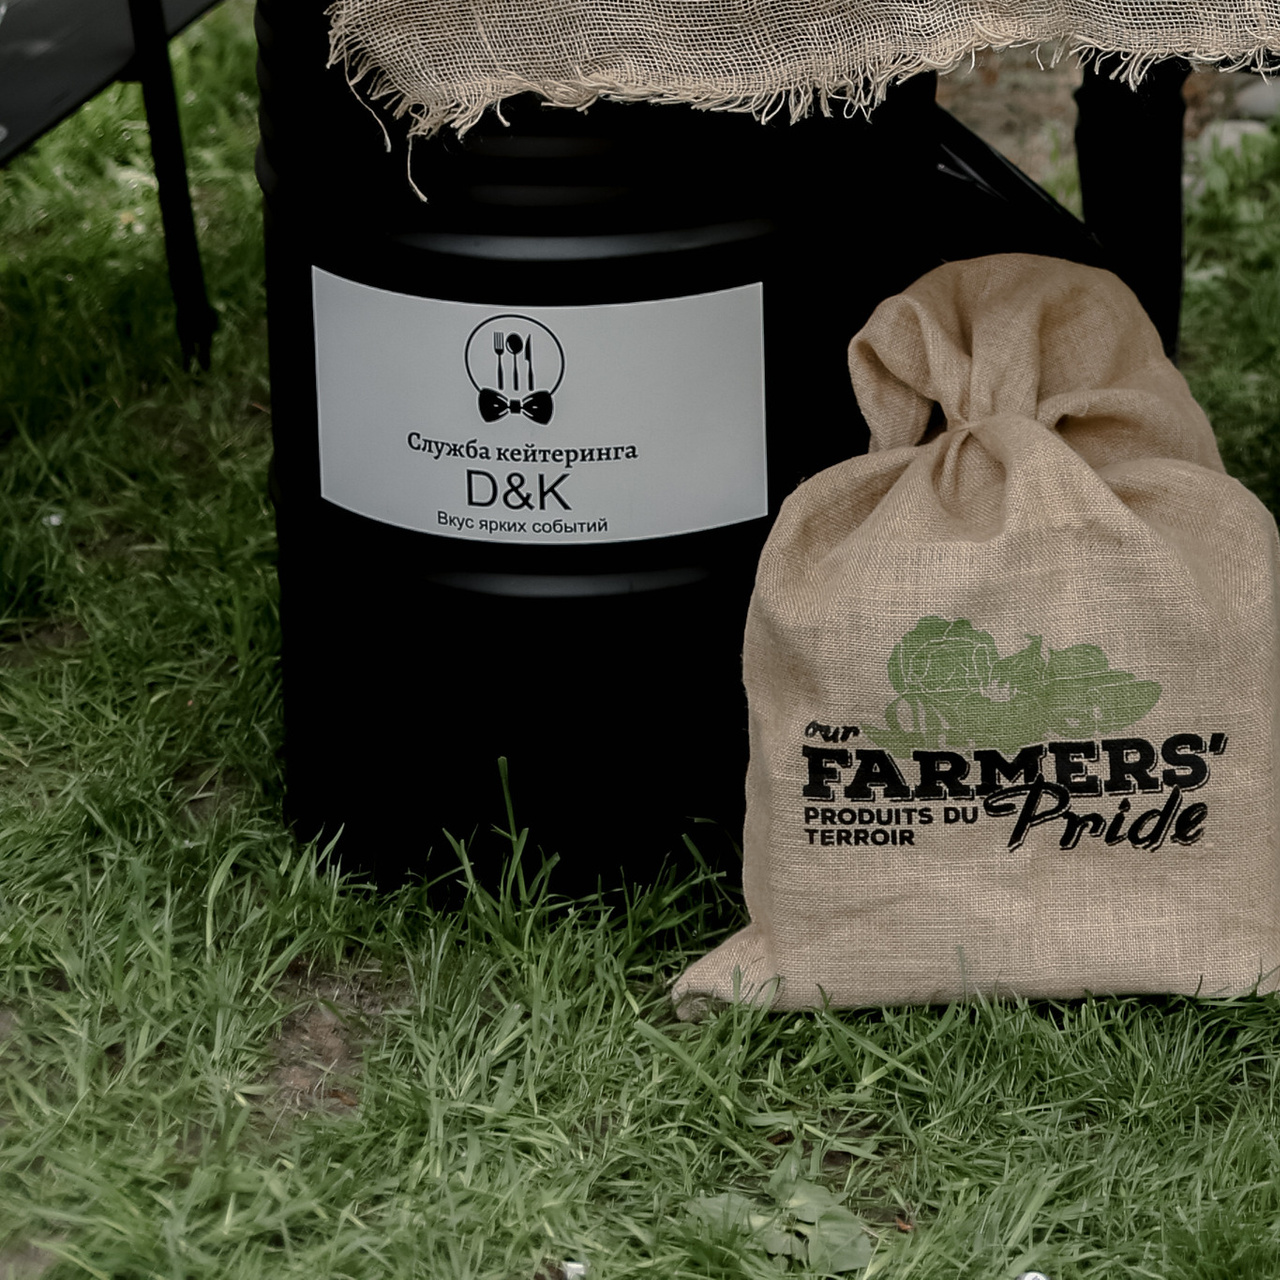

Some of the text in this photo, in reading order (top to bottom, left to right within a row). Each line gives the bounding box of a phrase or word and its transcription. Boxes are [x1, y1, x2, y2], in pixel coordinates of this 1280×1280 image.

[407, 432, 638, 468] Служба кейтеринга
[466, 469, 572, 511] D&K
[437, 511, 608, 533] Вкус ярких событий
[804, 720, 860, 743] our
[804, 805, 979, 826] PRODUITS DU
[984, 773, 1209, 852] Pride
[804, 828, 915, 846] TERROIR
